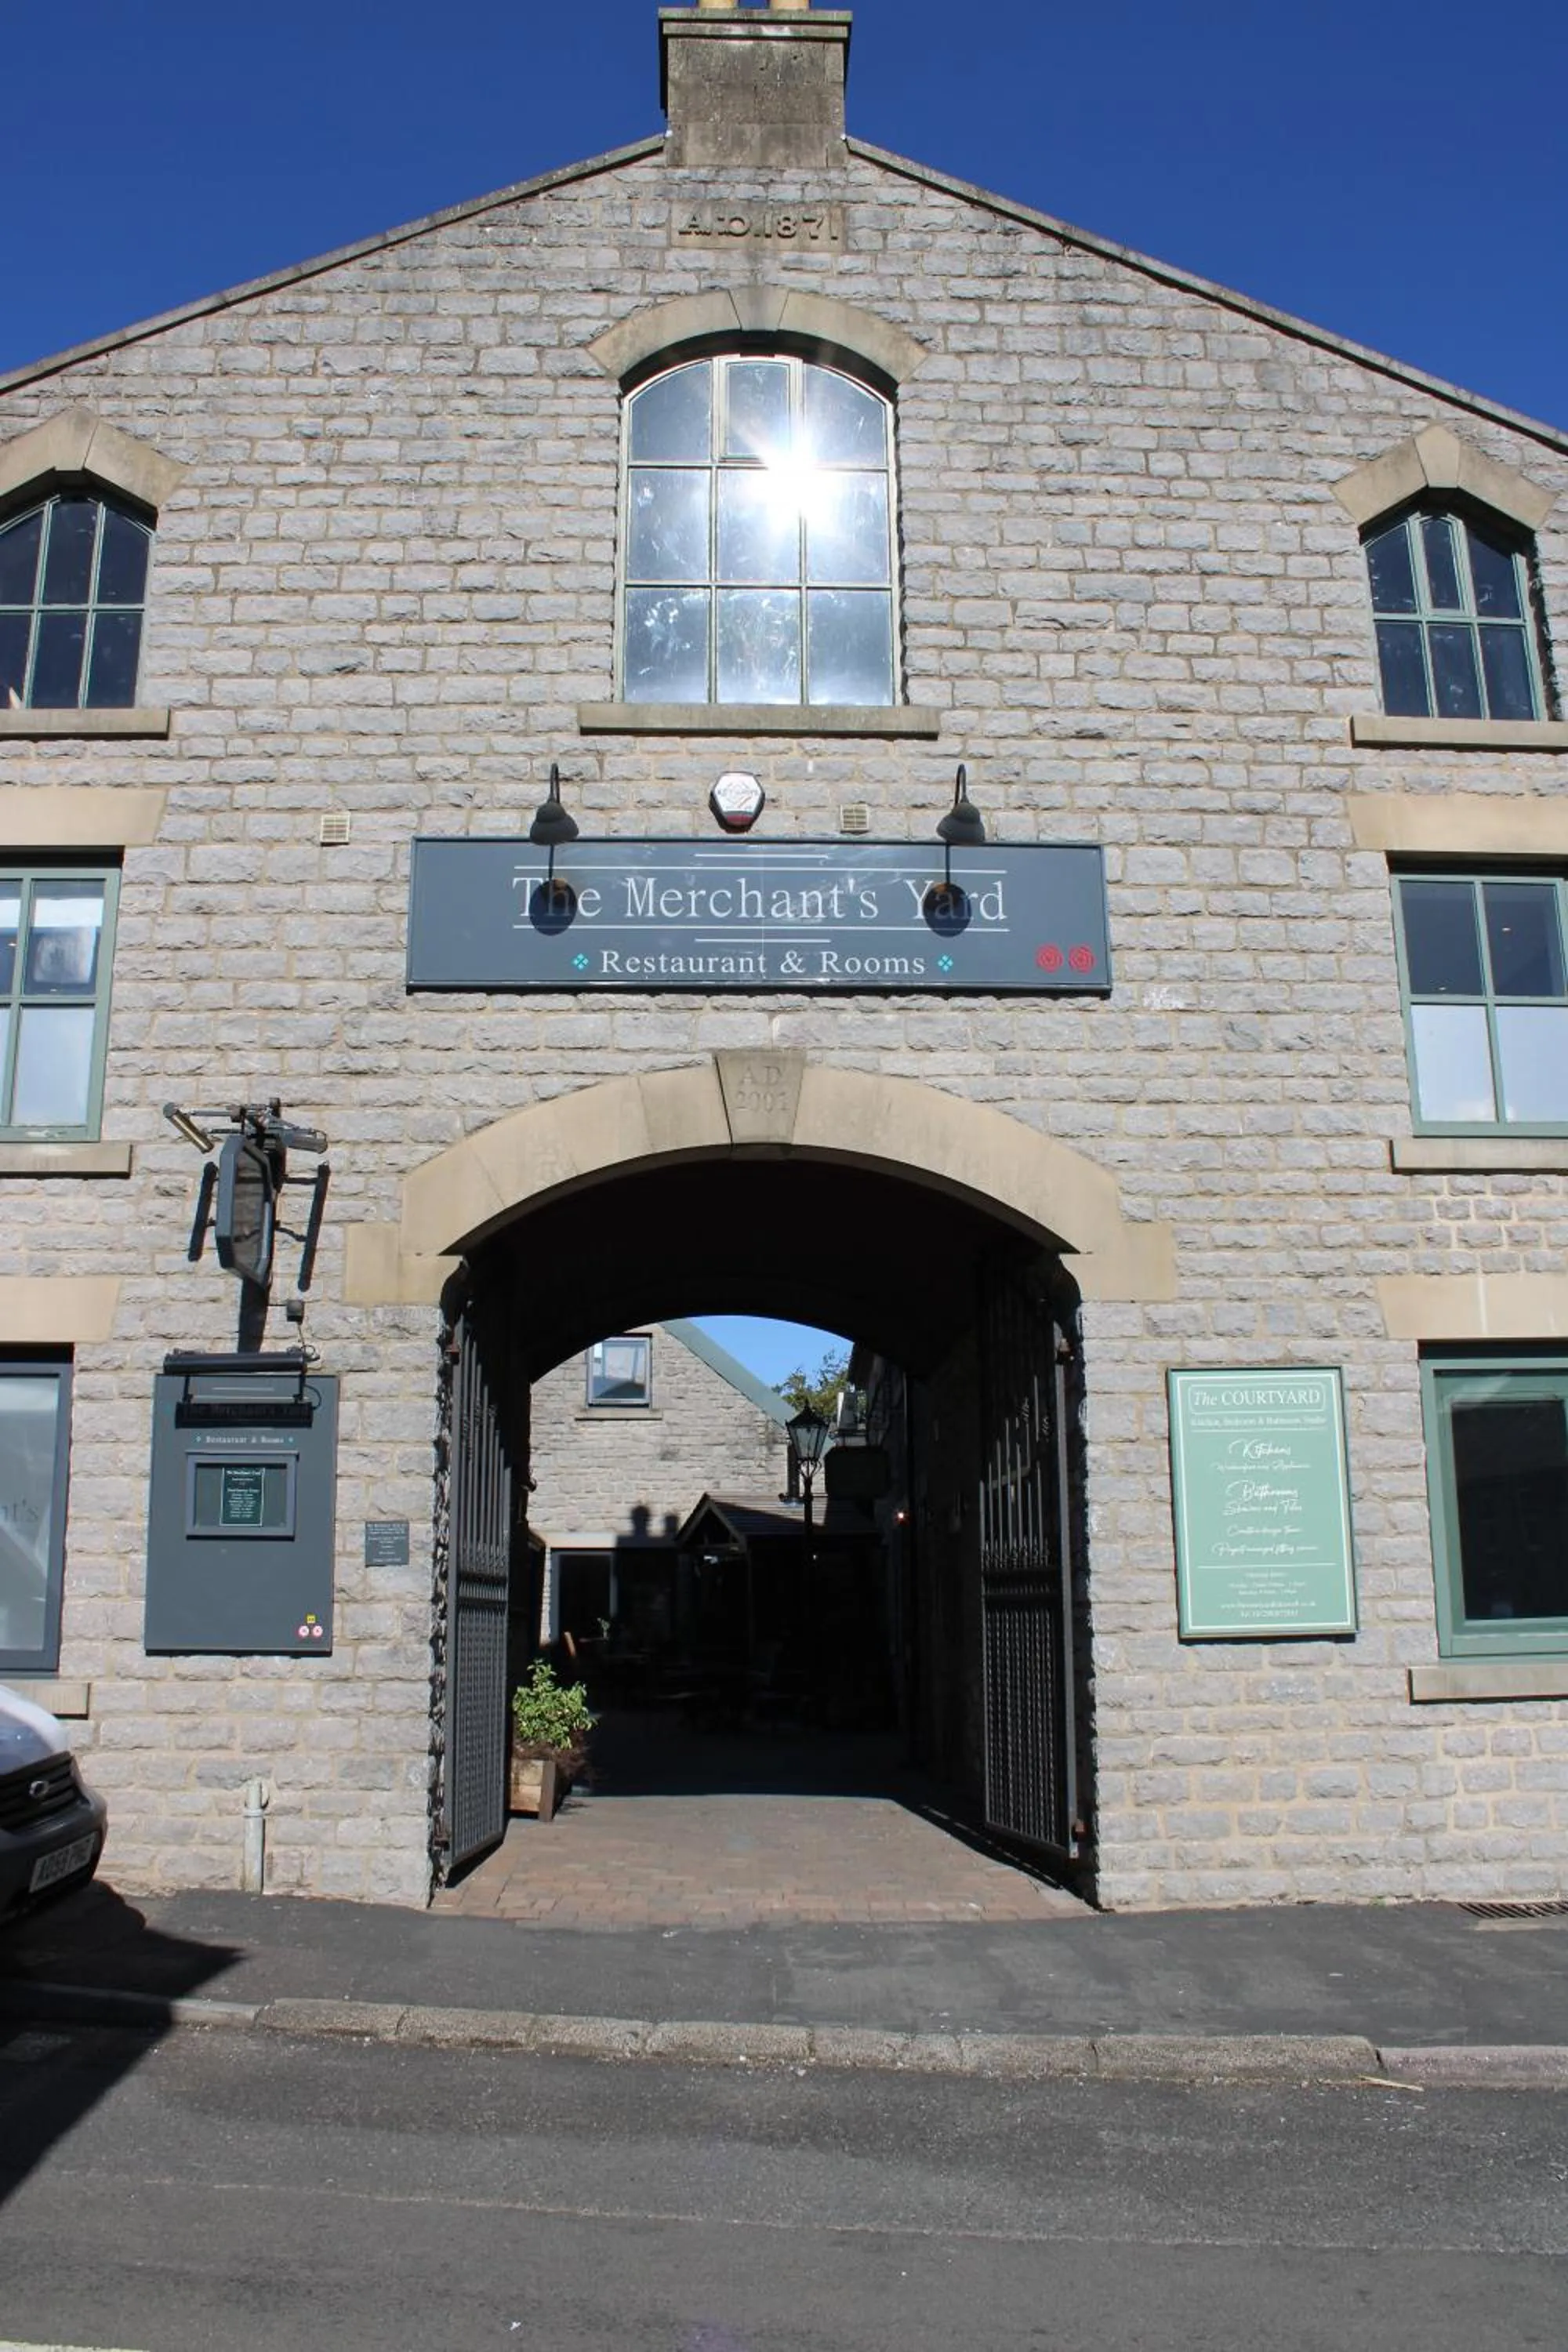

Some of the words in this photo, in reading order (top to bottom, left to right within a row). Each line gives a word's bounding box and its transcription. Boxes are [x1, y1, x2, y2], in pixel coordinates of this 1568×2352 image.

[512, 877, 603, 917] The
[624, 877, 879, 920] Merchant's
[903, 879, 1007, 920] Yard
[601, 950, 767, 975] Restaurant
[780, 951, 806, 975] &
[821, 951, 925, 975] Rooms
[1193, 1391, 1218, 1406] The
[1221, 1388, 1320, 1406] COURTYARD
